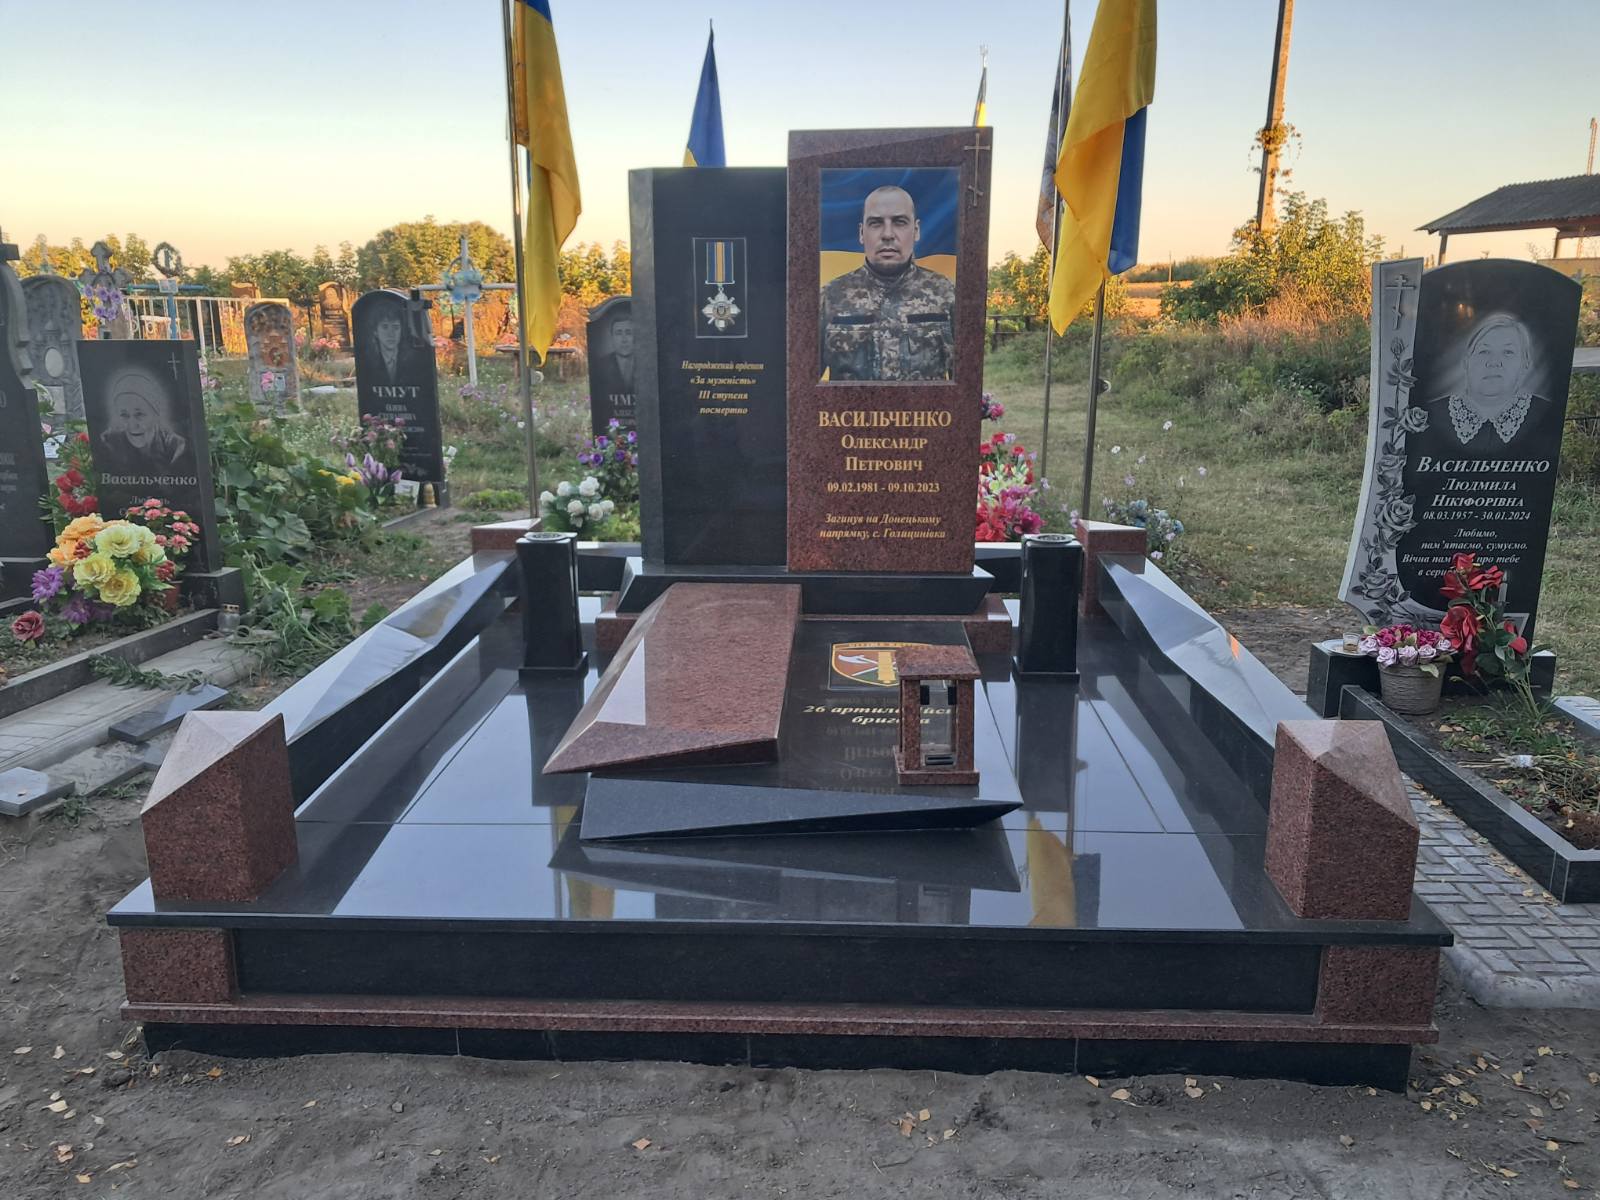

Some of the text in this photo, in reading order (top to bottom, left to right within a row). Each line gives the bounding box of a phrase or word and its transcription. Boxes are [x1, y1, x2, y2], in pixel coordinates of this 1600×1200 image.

[690, 375, 756, 386] «За мужність»
[372, 386, 420, 398] ЧМУТ
[712, 392, 749, 402] ступеня
[700, 407, 748, 416] посмертно
[818, 410, 952, 427] ВАСИЛЬЧЕНКО
[841, 434, 928, 450] ОЛЕКСАНДР
[845, 456, 923, 471] ПЕТРОВИЧ
[1416, 456, 1550, 473] ВАСИЛЬЧЕНКО
[101, 472, 197, 486] Васильченко
[1442, 478, 1517, 492] ЛЮДМИЛА
[827, 482, 878, 493] 09.02.1981
[888, 482, 940, 493] 09.10.2023
[1431, 494, 1525, 508] НІКІФОРІВНА
[825, 513, 863, 525] Загинув
[879, 513, 942, 525] Донецькому
[1422, 510, 1474, 520] 08.03.1957
[1481, 511, 1531, 521] 30.01.2024
[1454, 527, 1498, 539] Любимо,
[1486, 543, 1528, 552] сумуємо.
[1402, 554, 1430, 564] Вічна
[1477, 556, 1494, 566] про
[1497, 555, 1520, 564] тебе
[802, 705, 826, 713] 26
[851, 715, 930, 725] брига
